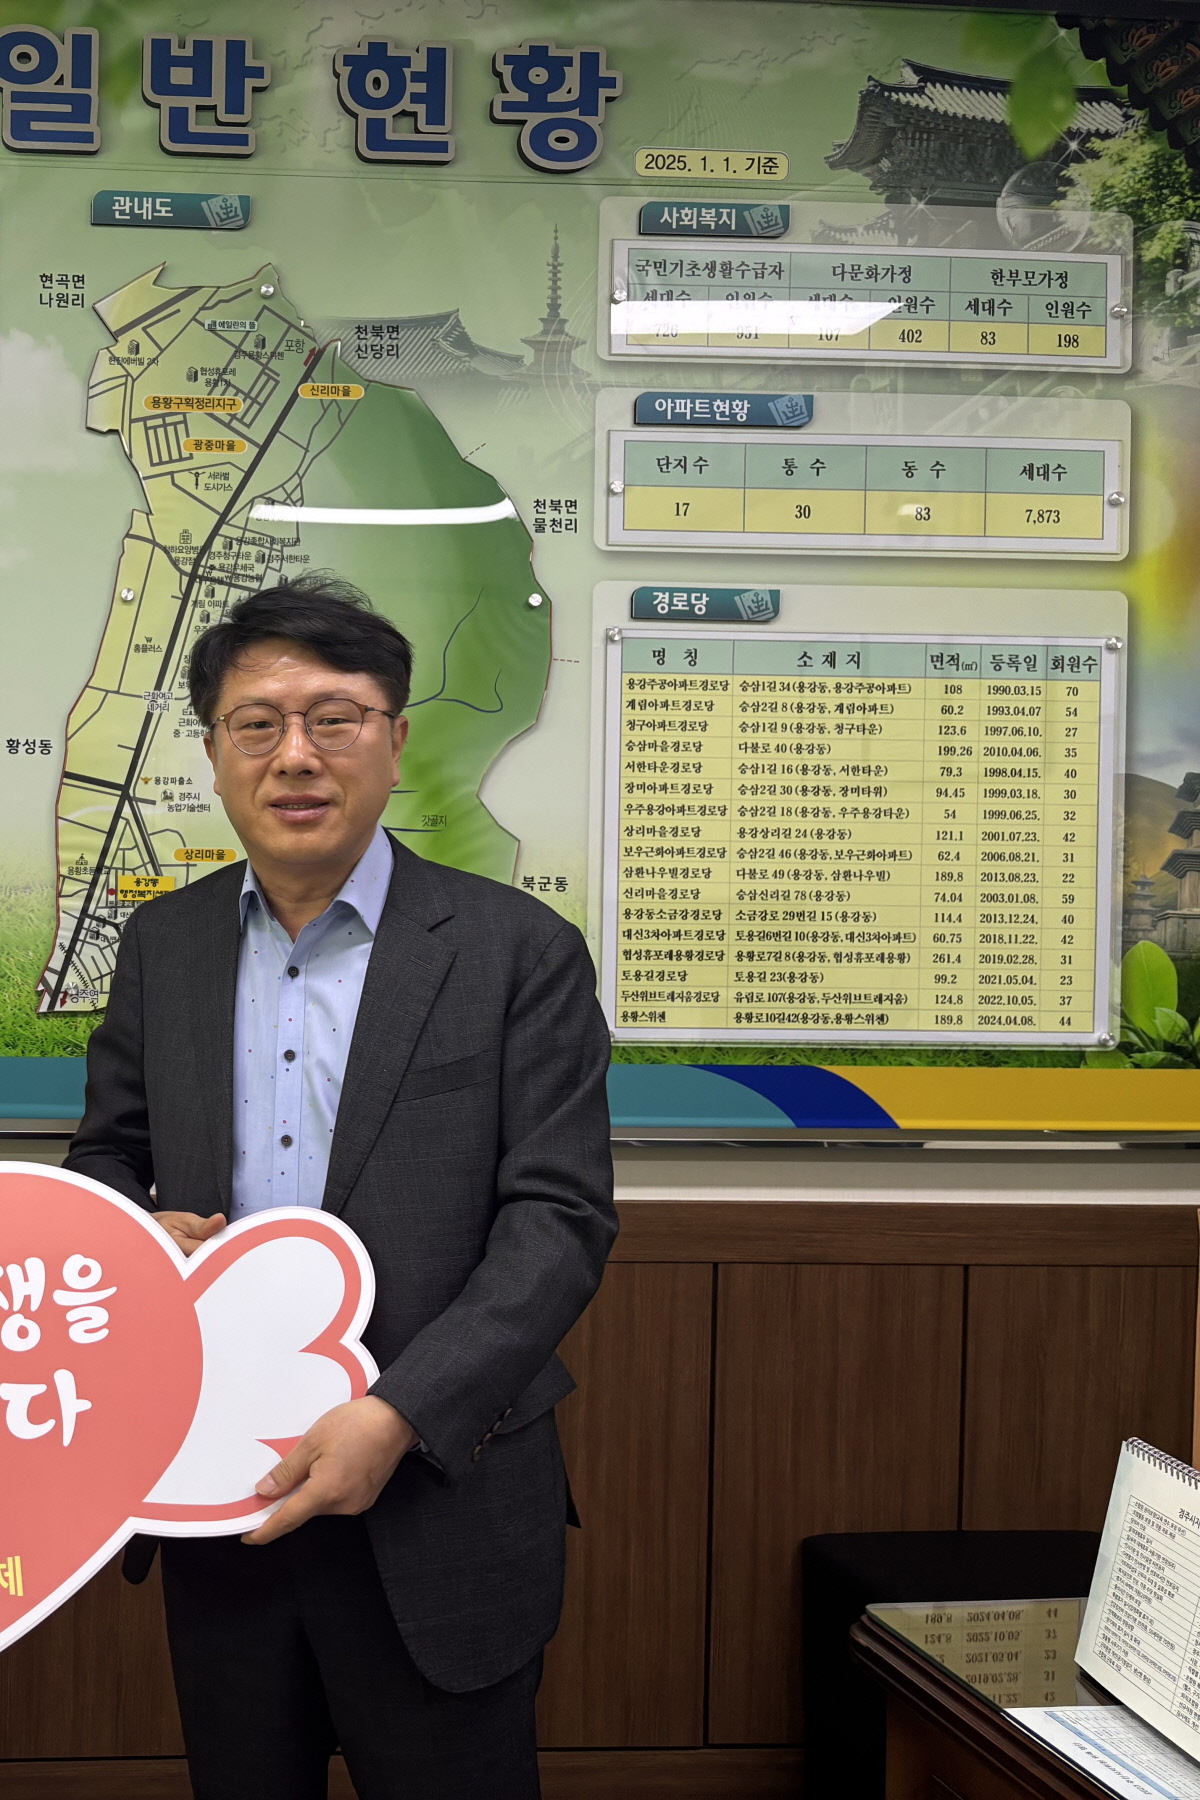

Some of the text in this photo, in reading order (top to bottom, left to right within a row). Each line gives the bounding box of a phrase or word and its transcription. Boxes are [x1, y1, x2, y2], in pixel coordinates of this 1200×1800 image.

[334, 35, 623, 173] 현황
[645, 154, 779, 174] 2025. 1. 1. 기준
[112, 197, 173, 219] 관내도
[660, 207, 735, 230] 사회복지
[39, 273, 84, 289] 현곡면
[635, 259, 1067, 289] 국민기초생활수급자 다문화가정 한부모가정
[40, 293, 84, 308] 나원리
[965, 298, 1092, 319] 세대수 인원수
[355, 325, 399, 340] 천북면
[899, 329, 1079, 348] 402 83 198
[355, 344, 399, 359] 신당리
[310, 385, 351, 397] 신리마을
[151, 396, 236, 410] 용황구획정리지구
[655, 399, 750, 421] 아파트현황
[193, 440, 236, 451] 광중마을
[656, 456, 1067, 481] 단지수 세대수
[208, 472, 229, 481] 서라벌
[204, 483, 233, 491] 도시가스
[533, 499, 577, 514] 천북면
[676, 503, 1060, 524] 17 30 83 7,873
[533, 518, 577, 533] 물천리
[653, 592, 709, 614] 경로당
[134, 644, 162, 653] 홈플러스
[990, 654, 1037, 672] 등록일
[1051, 655, 1098, 673] 회원수
[626, 678, 1078, 696] 용강주공아파트경로당 108 1990.03.15 70
[626, 699, 1077, 717] 계림아파트경로당 60.2 1993.04.07 54
[6, 738, 52, 755] 황성동
[984, 747, 1077, 757] 2010.04.06. 35
[625, 761, 703, 773] 서한타운경로당
[155, 777, 193, 785] 용강파출소
[184, 849, 225, 860] 상리마을
[522, 876, 568, 892] 북군동
[623, 887, 701, 900] 신리마을경로당
[621, 970, 688, 982] 토용길경로당
[935, 1015, 1071, 1026] 189.8 2024.04.08. 44
